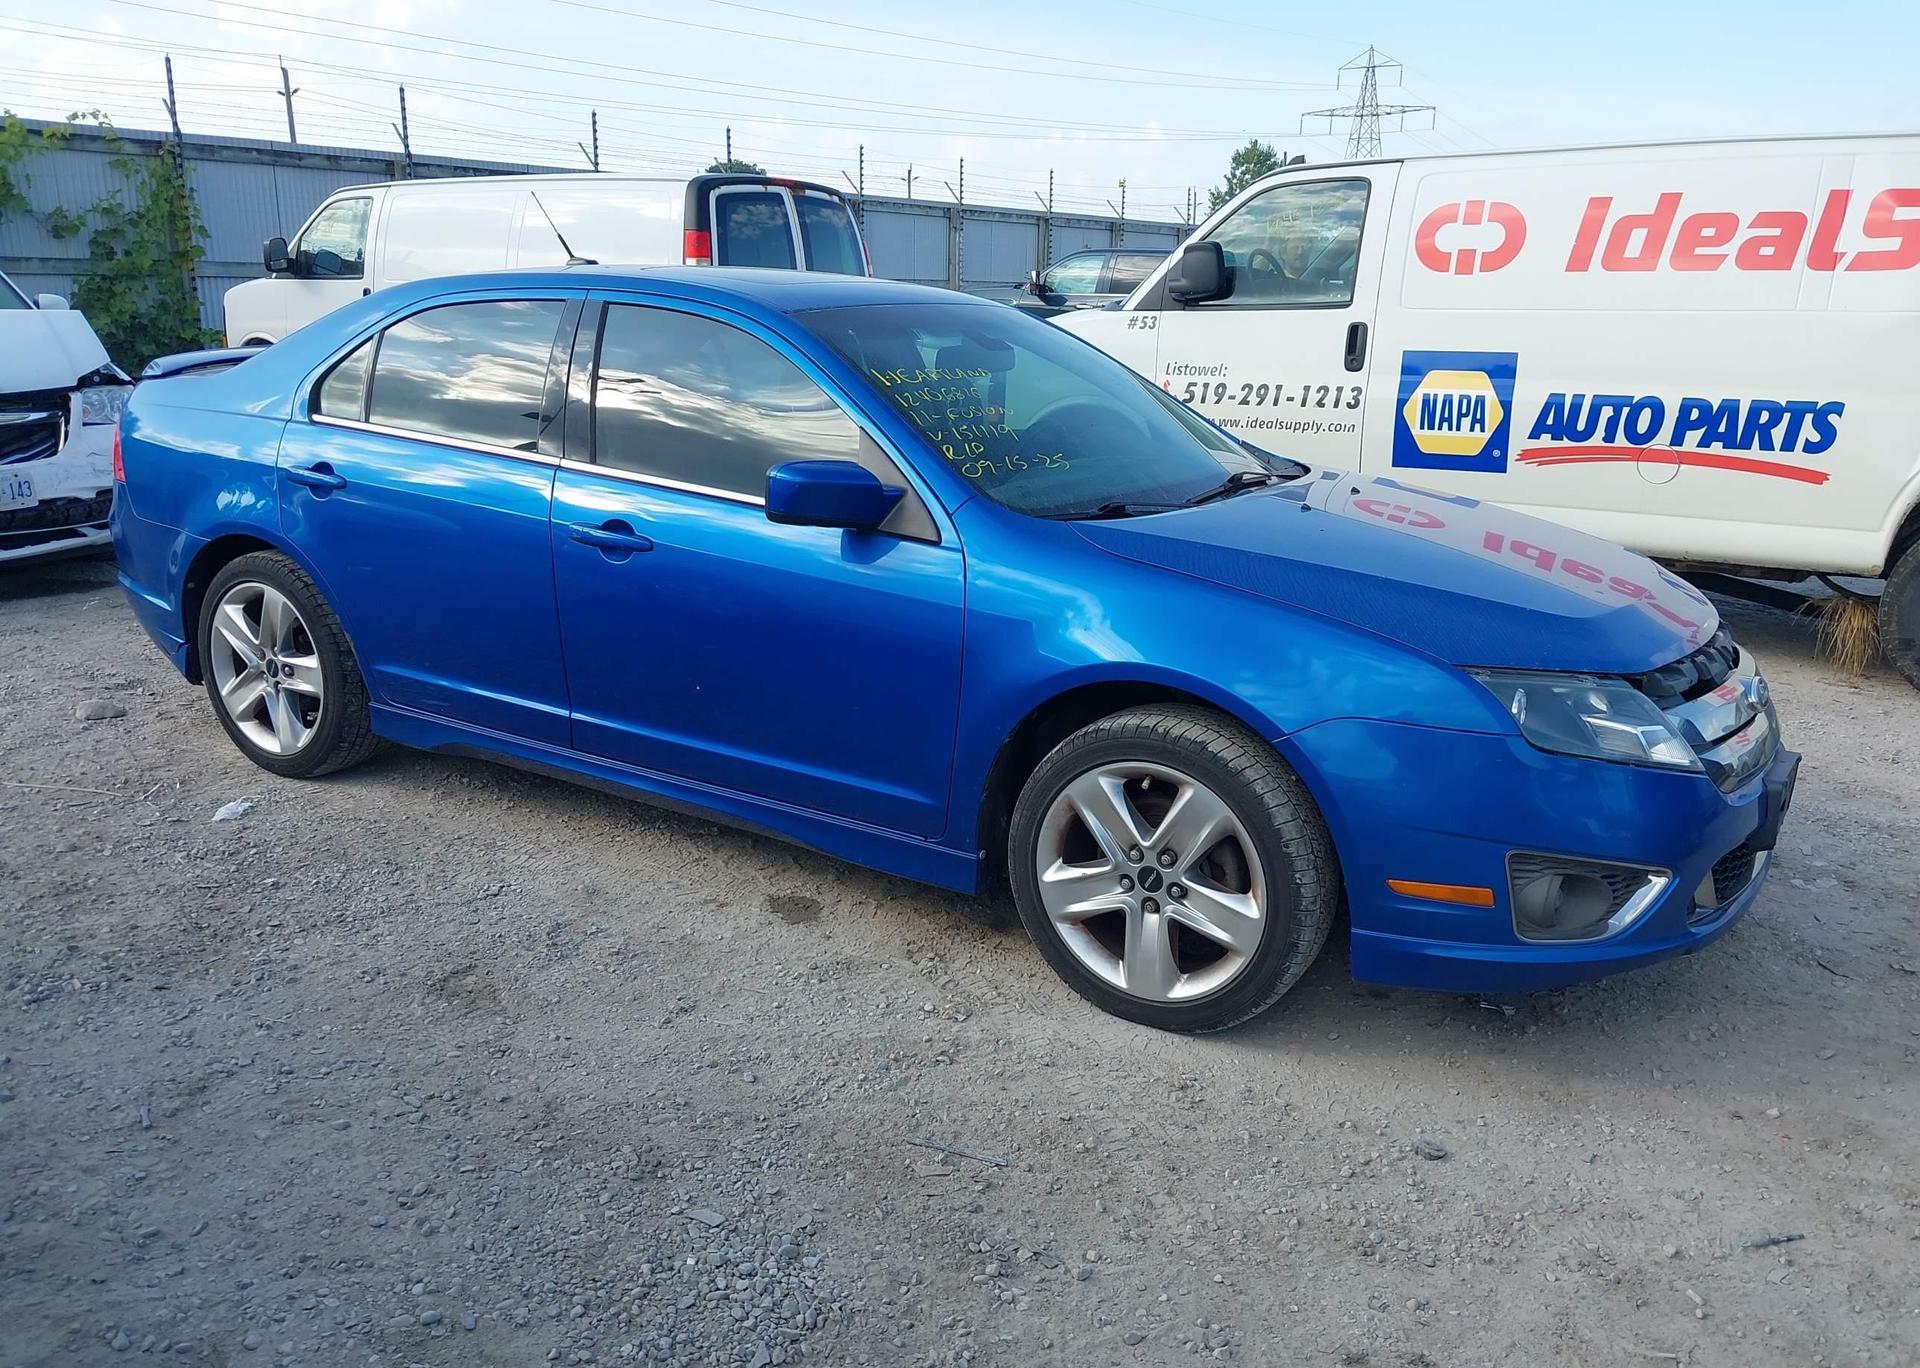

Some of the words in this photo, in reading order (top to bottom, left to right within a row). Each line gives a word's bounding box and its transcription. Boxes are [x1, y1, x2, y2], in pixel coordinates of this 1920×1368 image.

[1127, 315, 1158, 330] #53
[1165, 362, 1229, 378] Listowel:
[1182, 382, 1364, 410] 519-291-1213
[1419, 392, 1487, 433] NAPA
[1528, 392, 1665, 446] AUTO
[1669, 396, 1847, 455] PARTS
